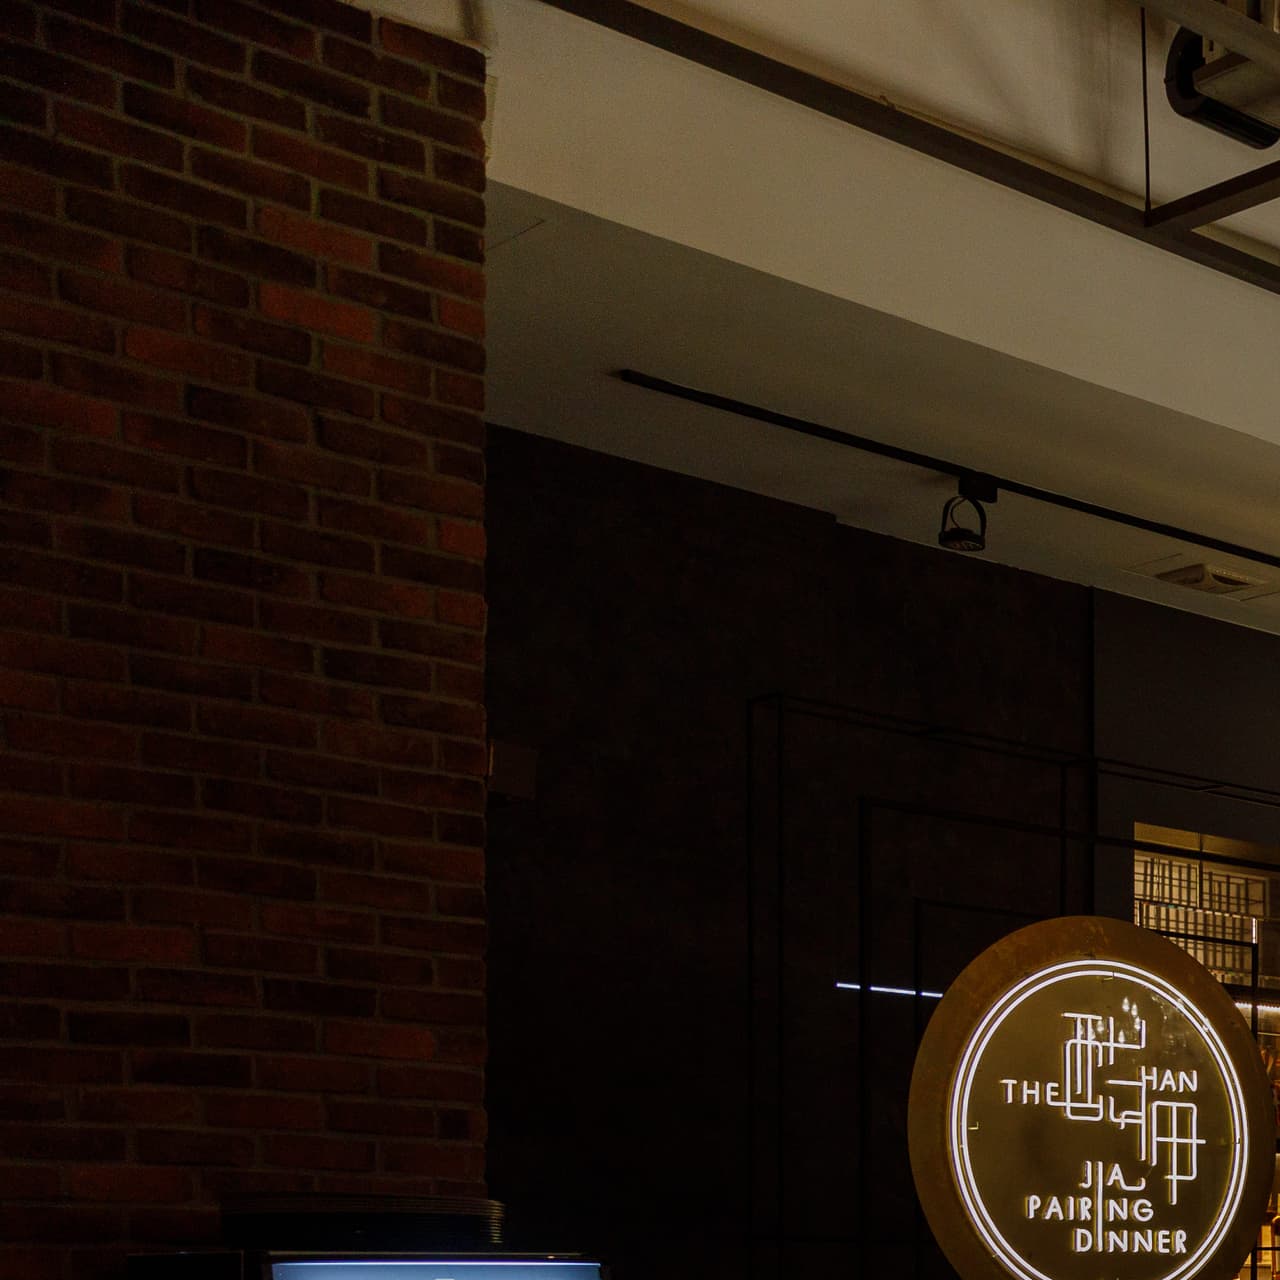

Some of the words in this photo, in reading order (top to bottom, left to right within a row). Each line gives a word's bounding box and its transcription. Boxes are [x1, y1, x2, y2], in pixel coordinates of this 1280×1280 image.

[1001, 1078, 1062, 1107] THE
[1140, 1065, 1198, 1093] HAN
[1078, 1160, 1126, 1190] JIA
[1026, 1194, 1155, 1223] PAIRING
[1074, 1228, 1188, 1254] DINNER
